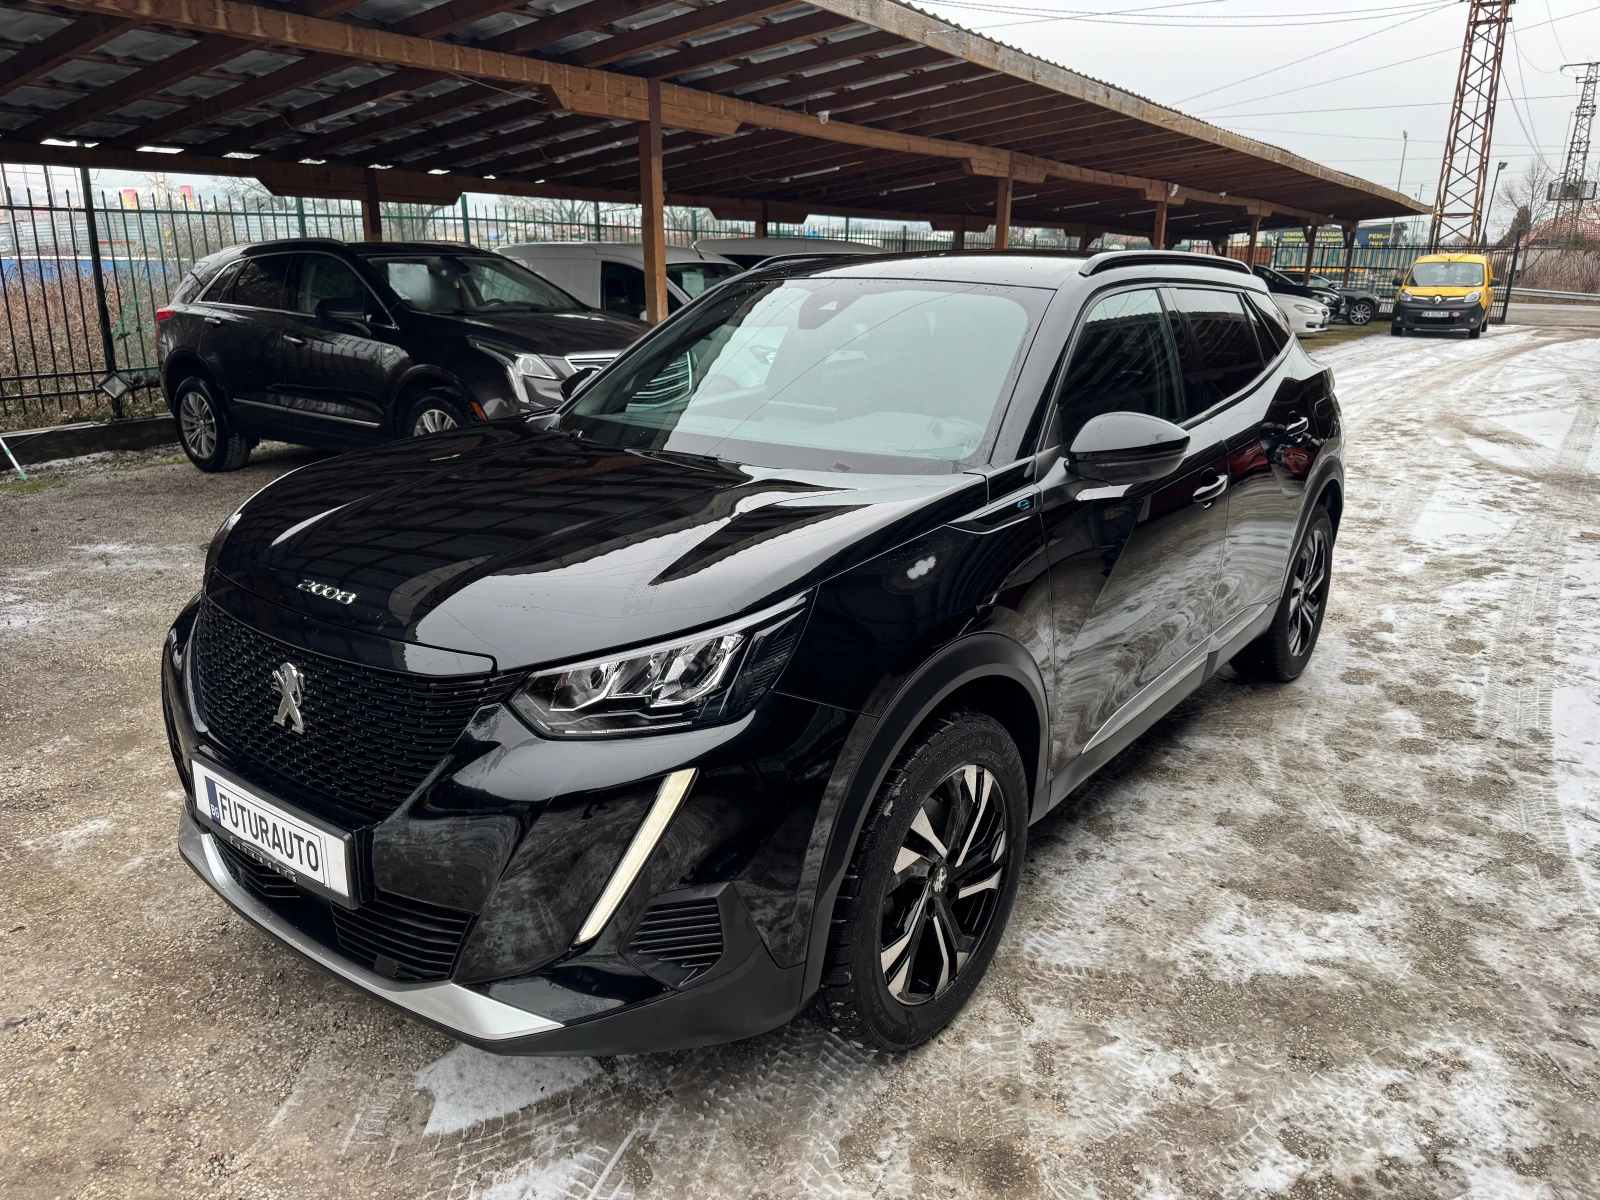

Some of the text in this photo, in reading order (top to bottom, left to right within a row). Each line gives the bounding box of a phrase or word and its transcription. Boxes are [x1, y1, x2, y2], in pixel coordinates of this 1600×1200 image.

[296, 580, 356, 604] 2008
[210, 792, 319, 872] BG FUTURAUTO
